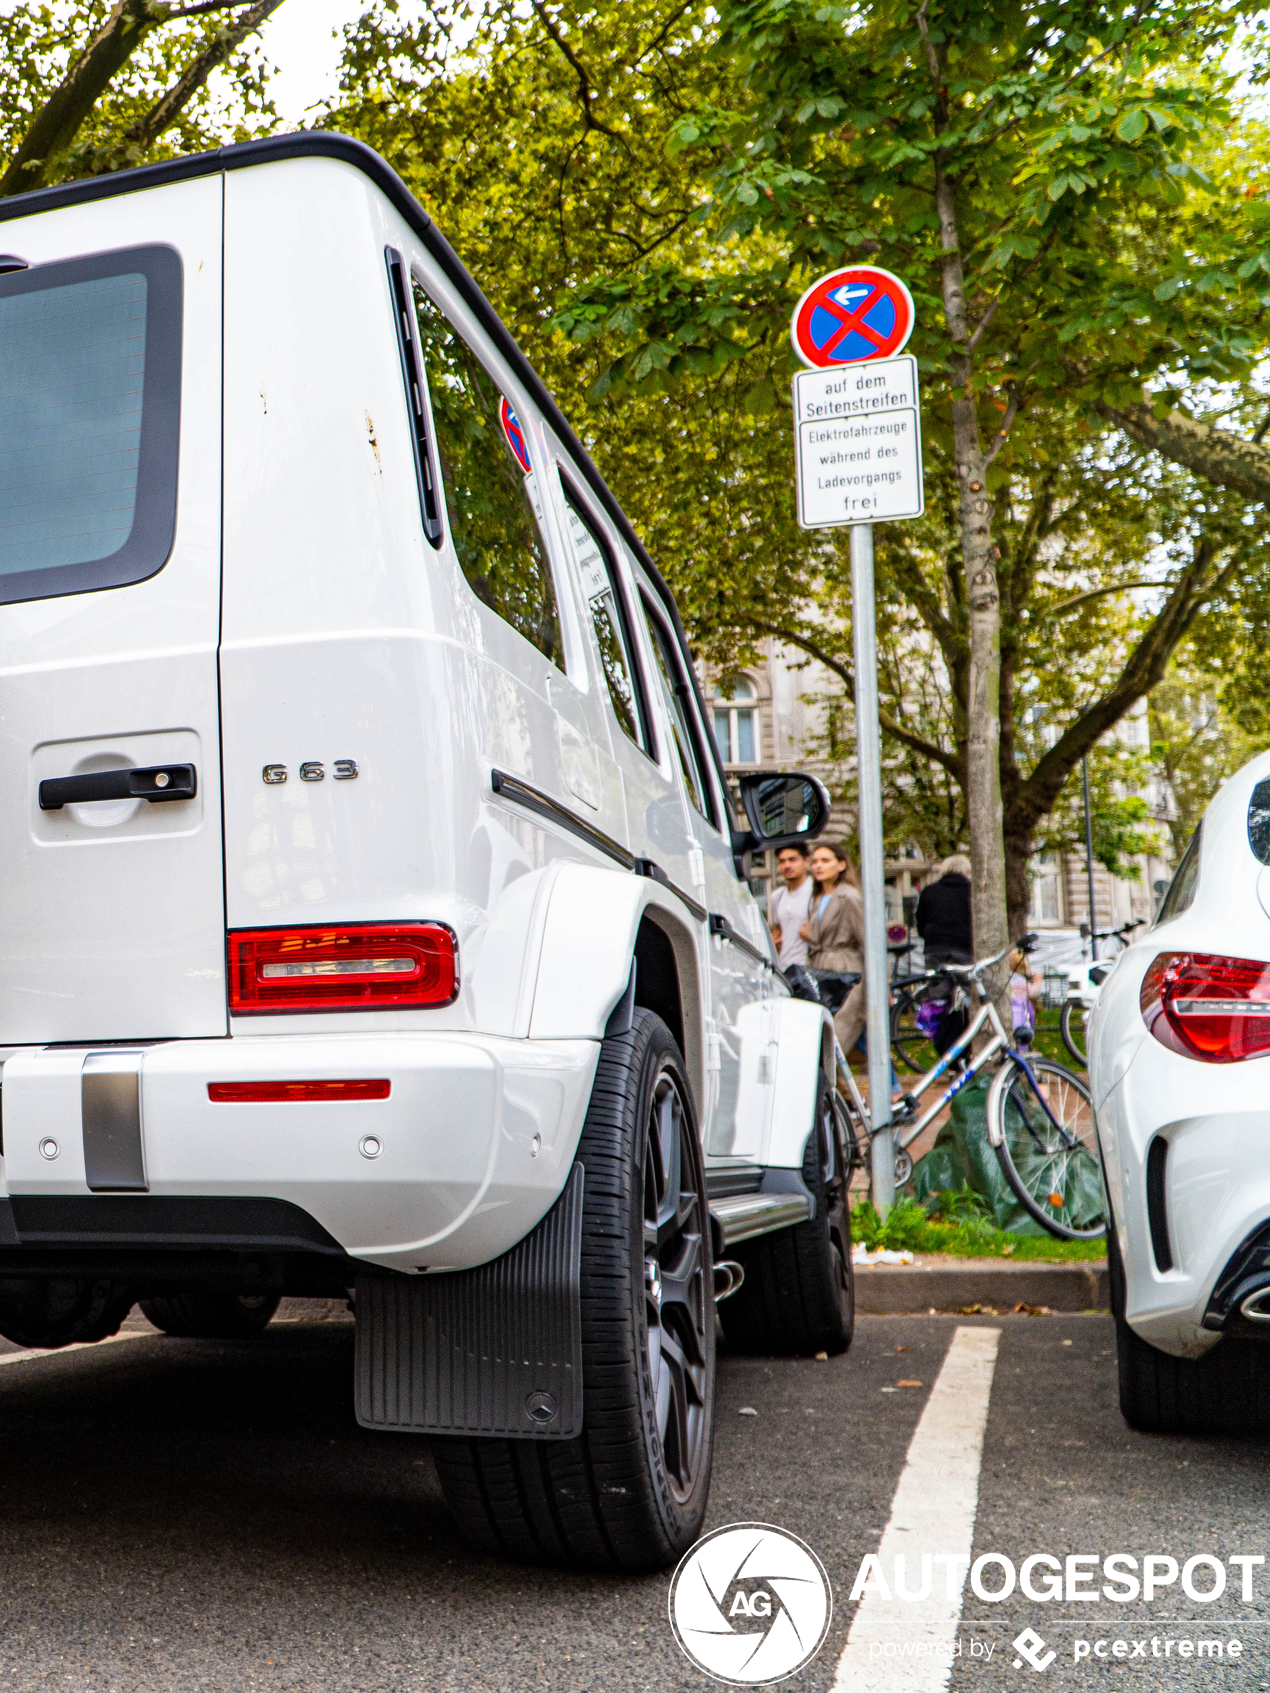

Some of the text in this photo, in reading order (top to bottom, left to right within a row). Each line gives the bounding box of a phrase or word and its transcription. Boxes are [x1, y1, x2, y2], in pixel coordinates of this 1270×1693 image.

[825, 376, 886, 395] auf dem
[806, 393, 908, 417] Seitenstreifen
[809, 422, 908, 444] Elektrofahrzeuge
[819, 446, 899, 465] während des
[818, 470, 902, 489] Ladevorgangs
[844, 493, 878, 510] frei
